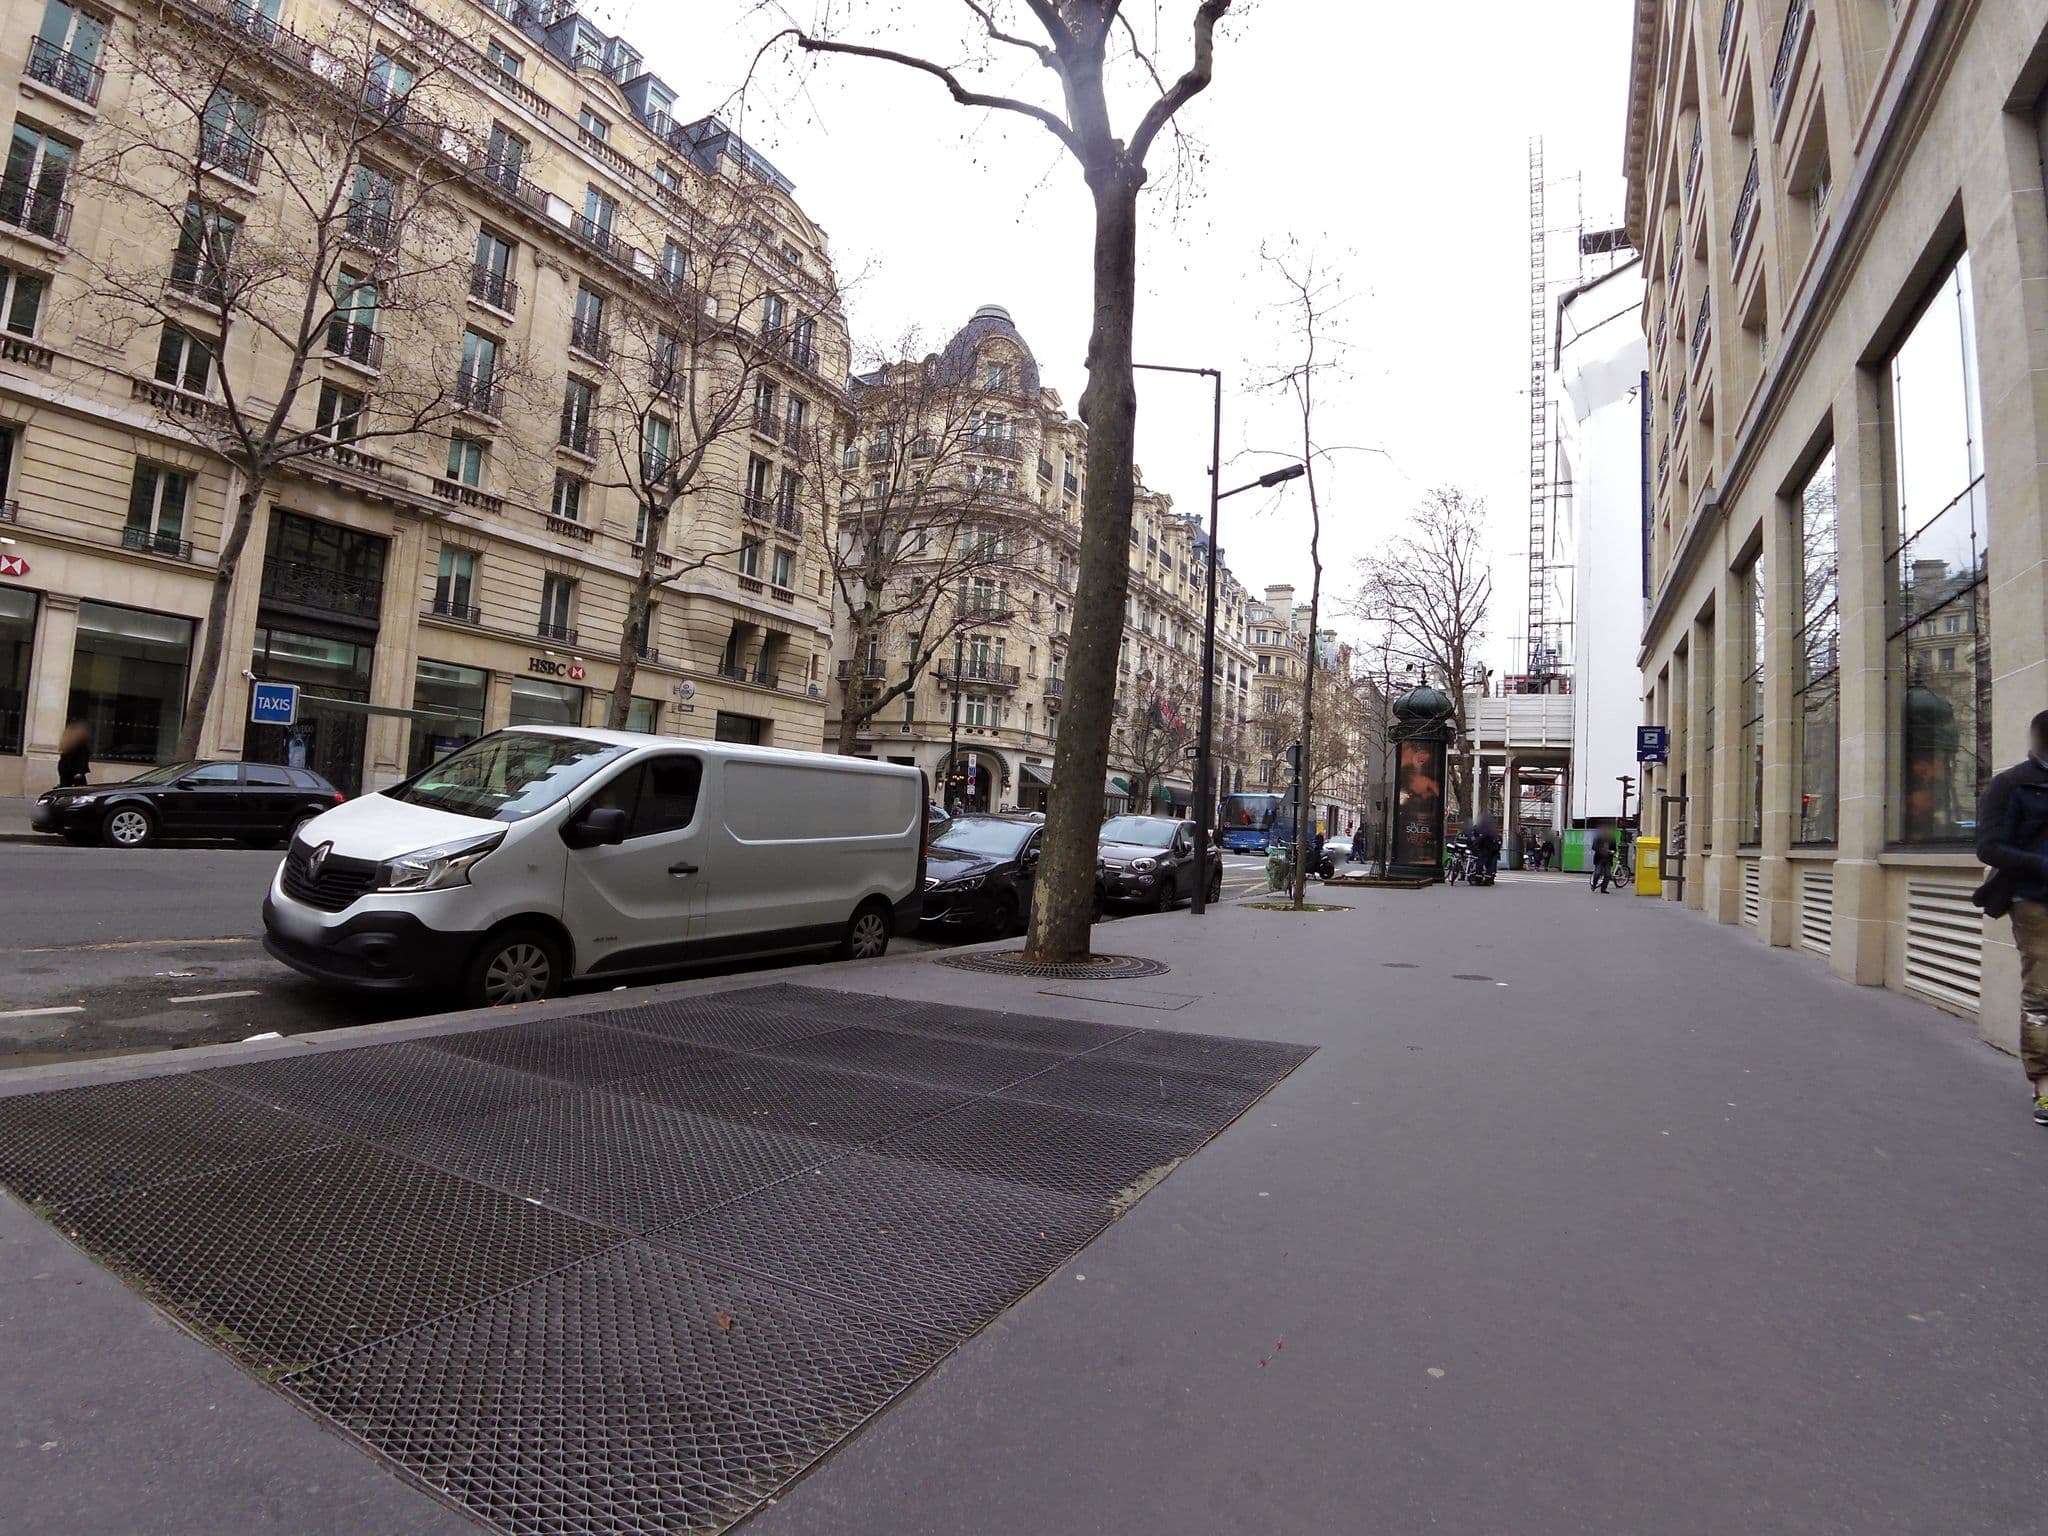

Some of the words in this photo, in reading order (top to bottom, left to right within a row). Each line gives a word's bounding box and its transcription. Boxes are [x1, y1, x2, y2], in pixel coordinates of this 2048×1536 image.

[528, 657, 567, 677] HSBC
[257, 697, 291, 711] TAXIS
[1406, 825, 1432, 834] SOLEIL
